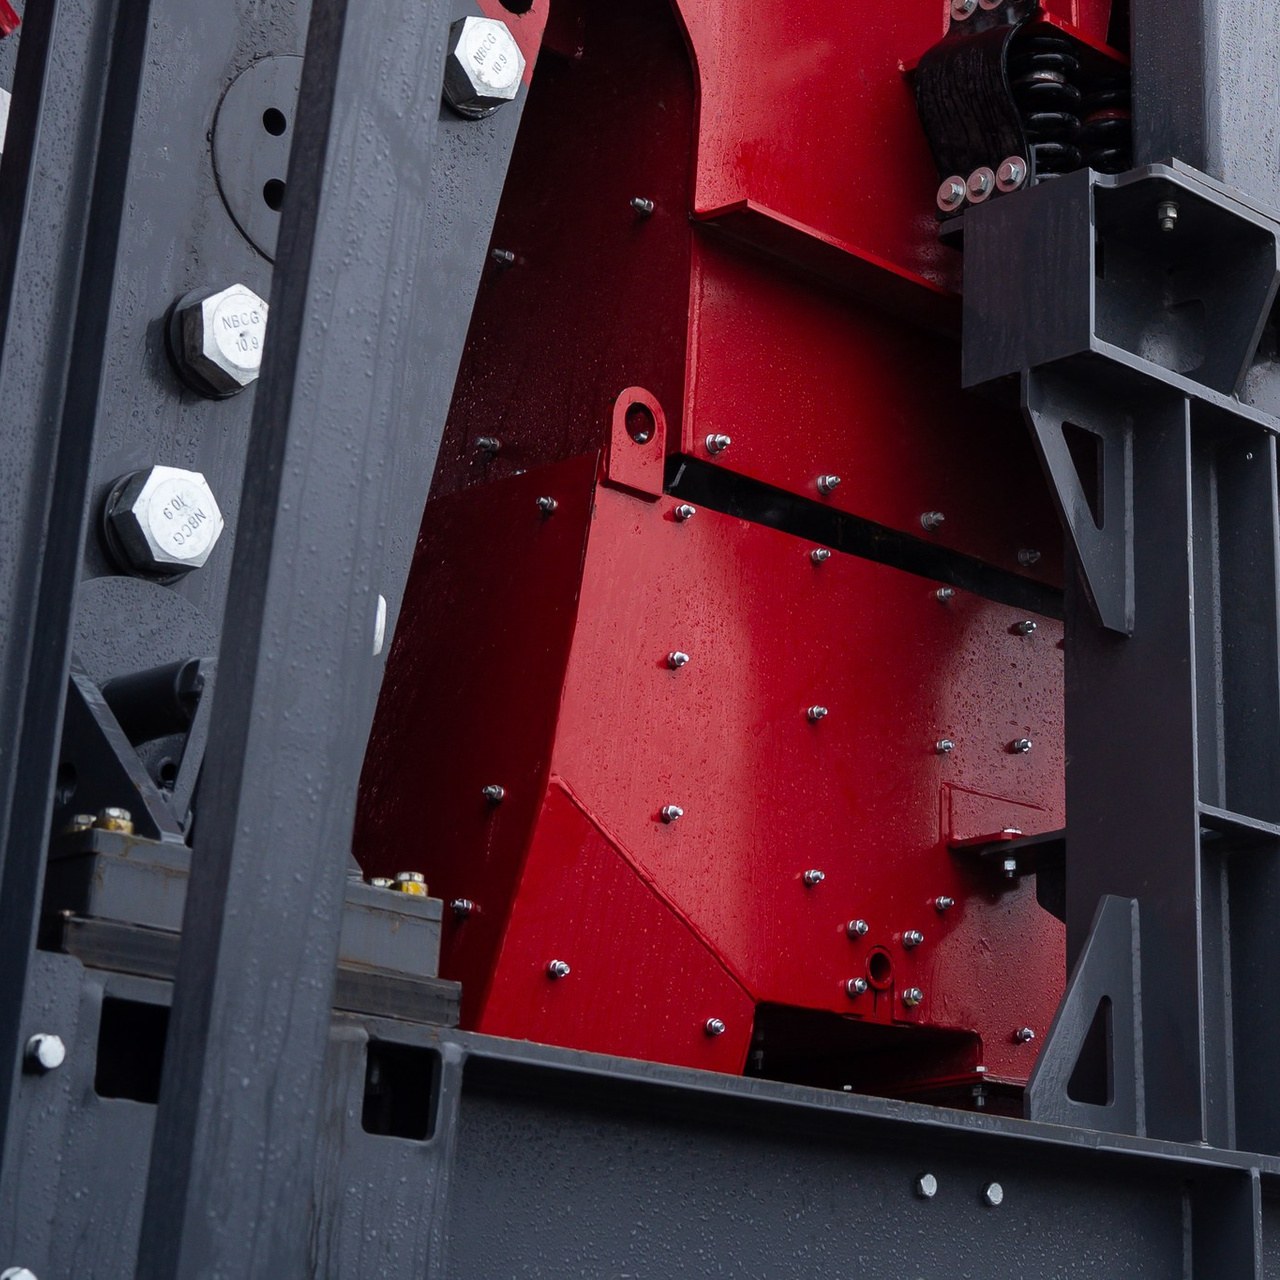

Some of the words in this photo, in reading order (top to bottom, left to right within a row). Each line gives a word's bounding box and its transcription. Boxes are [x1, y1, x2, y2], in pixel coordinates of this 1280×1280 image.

[473, 33, 497, 66] NBCG
[491, 53, 508, 75] 10.9
[221, 310, 260, 331] NBCG
[235, 336, 259, 353] 10.9
[173, 508, 207, 545] NBCG
